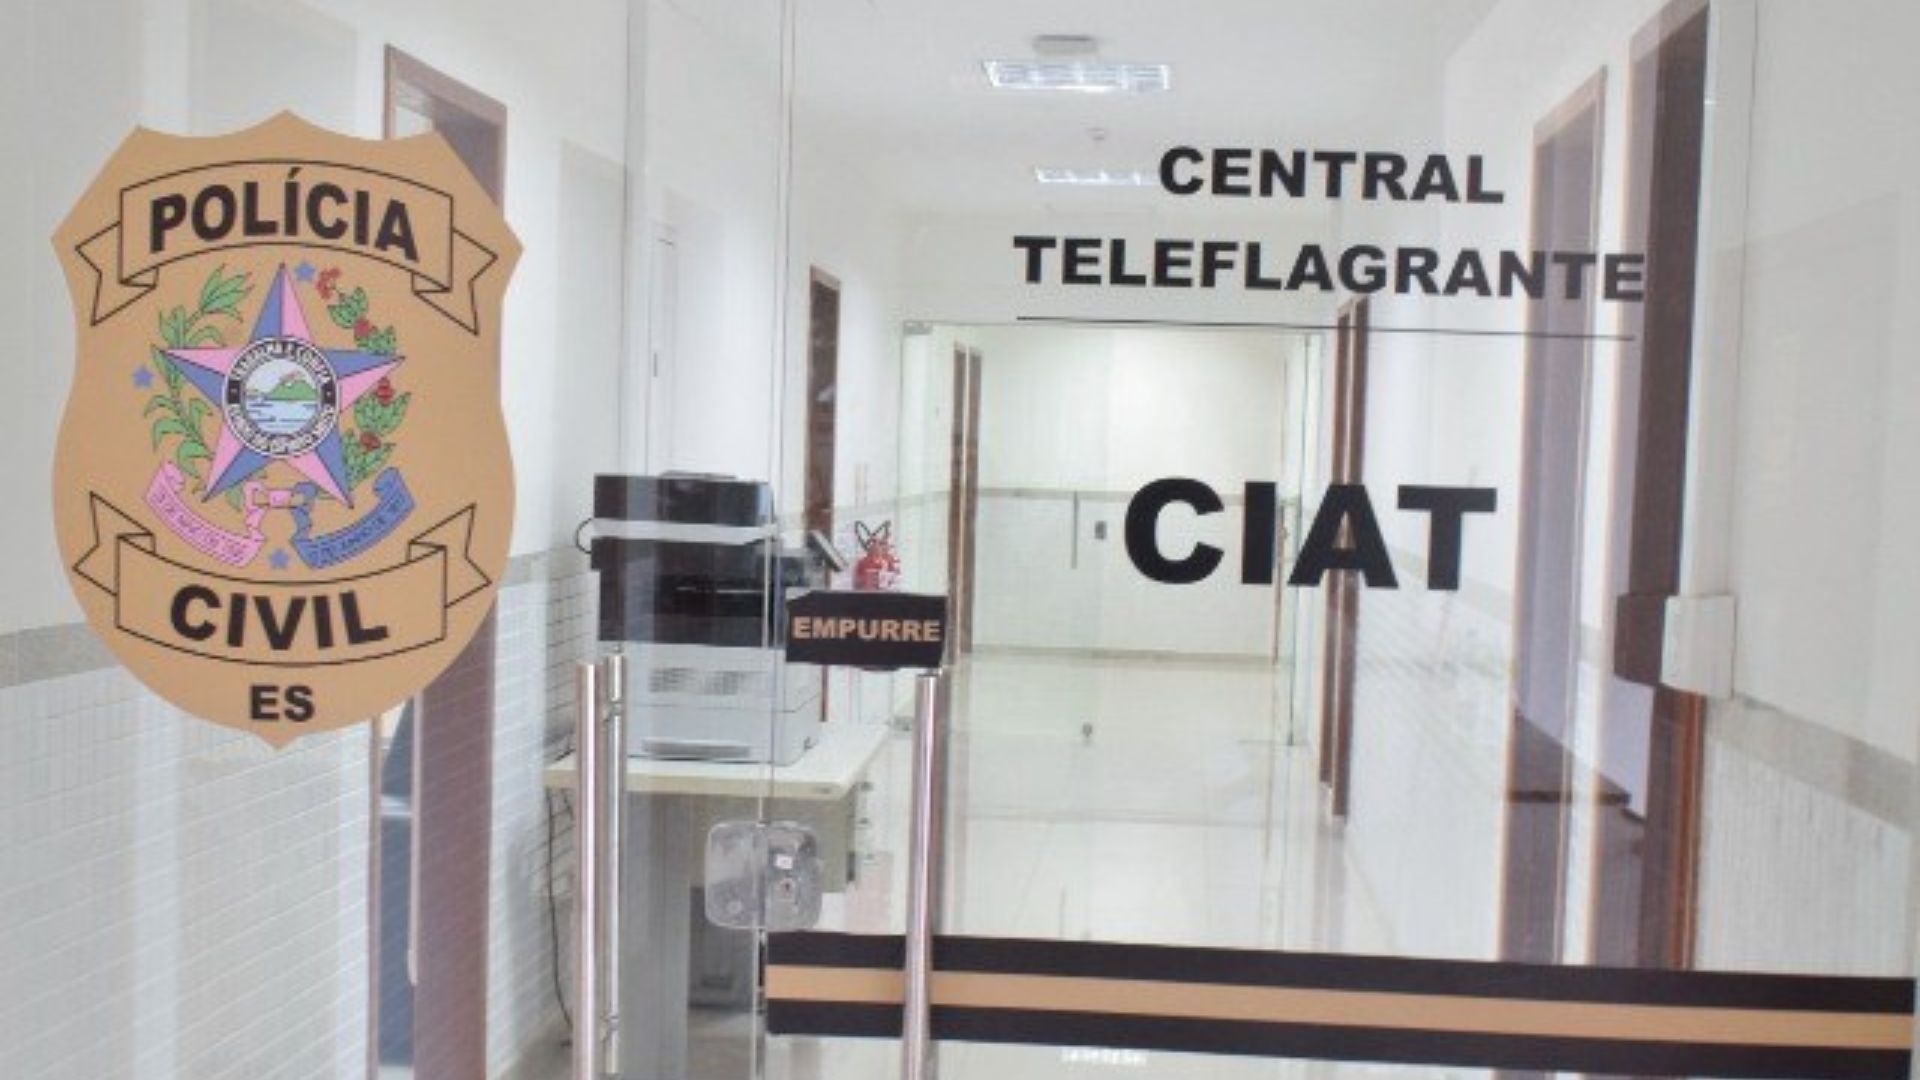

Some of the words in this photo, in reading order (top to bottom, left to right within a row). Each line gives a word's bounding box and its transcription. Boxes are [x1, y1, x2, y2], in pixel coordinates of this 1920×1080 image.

[1159, 146, 1504, 204] CENTRAL
[150, 167, 418, 263] POLÍCIA
[1013, 236, 1645, 301] TELEFLAGRANTE
[1125, 477, 1497, 591] CIAT
[170, 584, 389, 651] CIVIL
[792, 615, 942, 644] EMPURRE
[249, 684, 315, 723] ES
